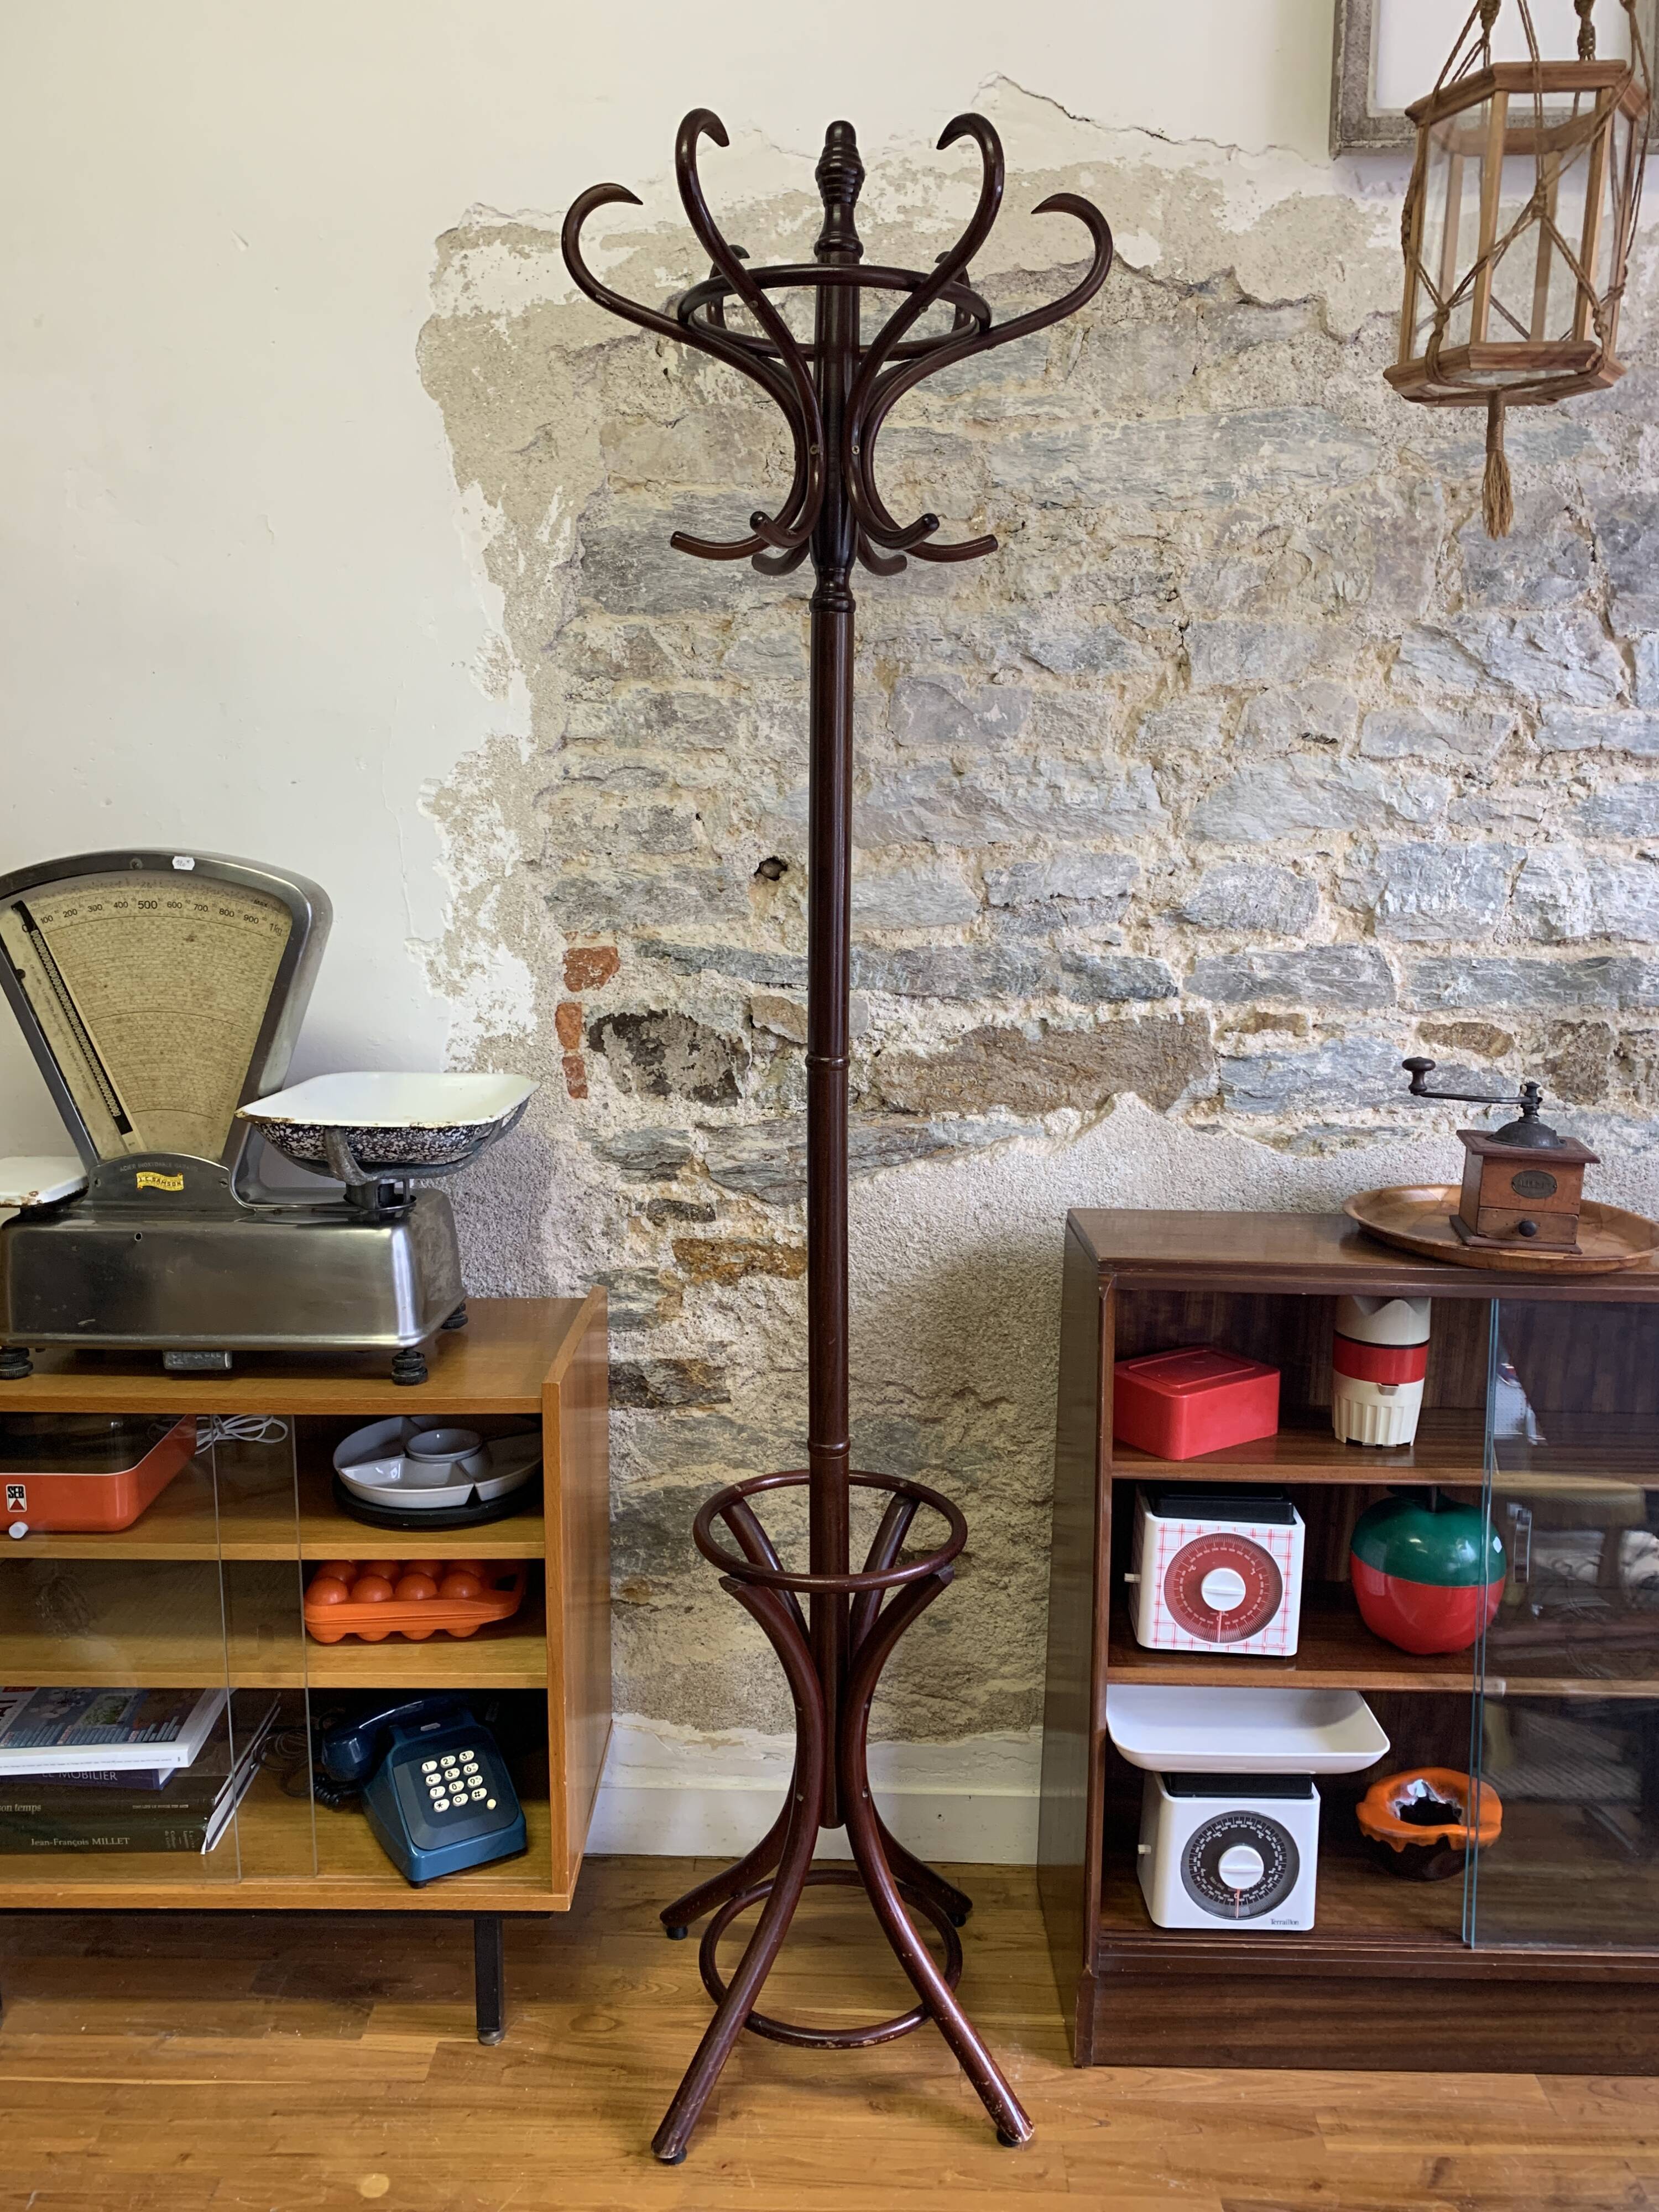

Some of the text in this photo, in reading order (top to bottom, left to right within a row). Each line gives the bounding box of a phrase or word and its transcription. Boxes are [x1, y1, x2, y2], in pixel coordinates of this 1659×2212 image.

[40, 915, 53, 924] 100
[62, 909, 78, 918] 200
[87, 904, 103, 912] 300
[138, 900, 158, 910] 500
[167, 901, 182, 909] 600
[194, 904, 208, 912] 700
[219, 908, 234, 917] 800
[243, 914, 259, 924] 900
[8, 1486, 24, 1498] SEB
[59, 1770, 118, 1781] MOBILIER
[15, 1803, 41, 1814] temps
[31, 1838, 89, 1847] Jean-François
